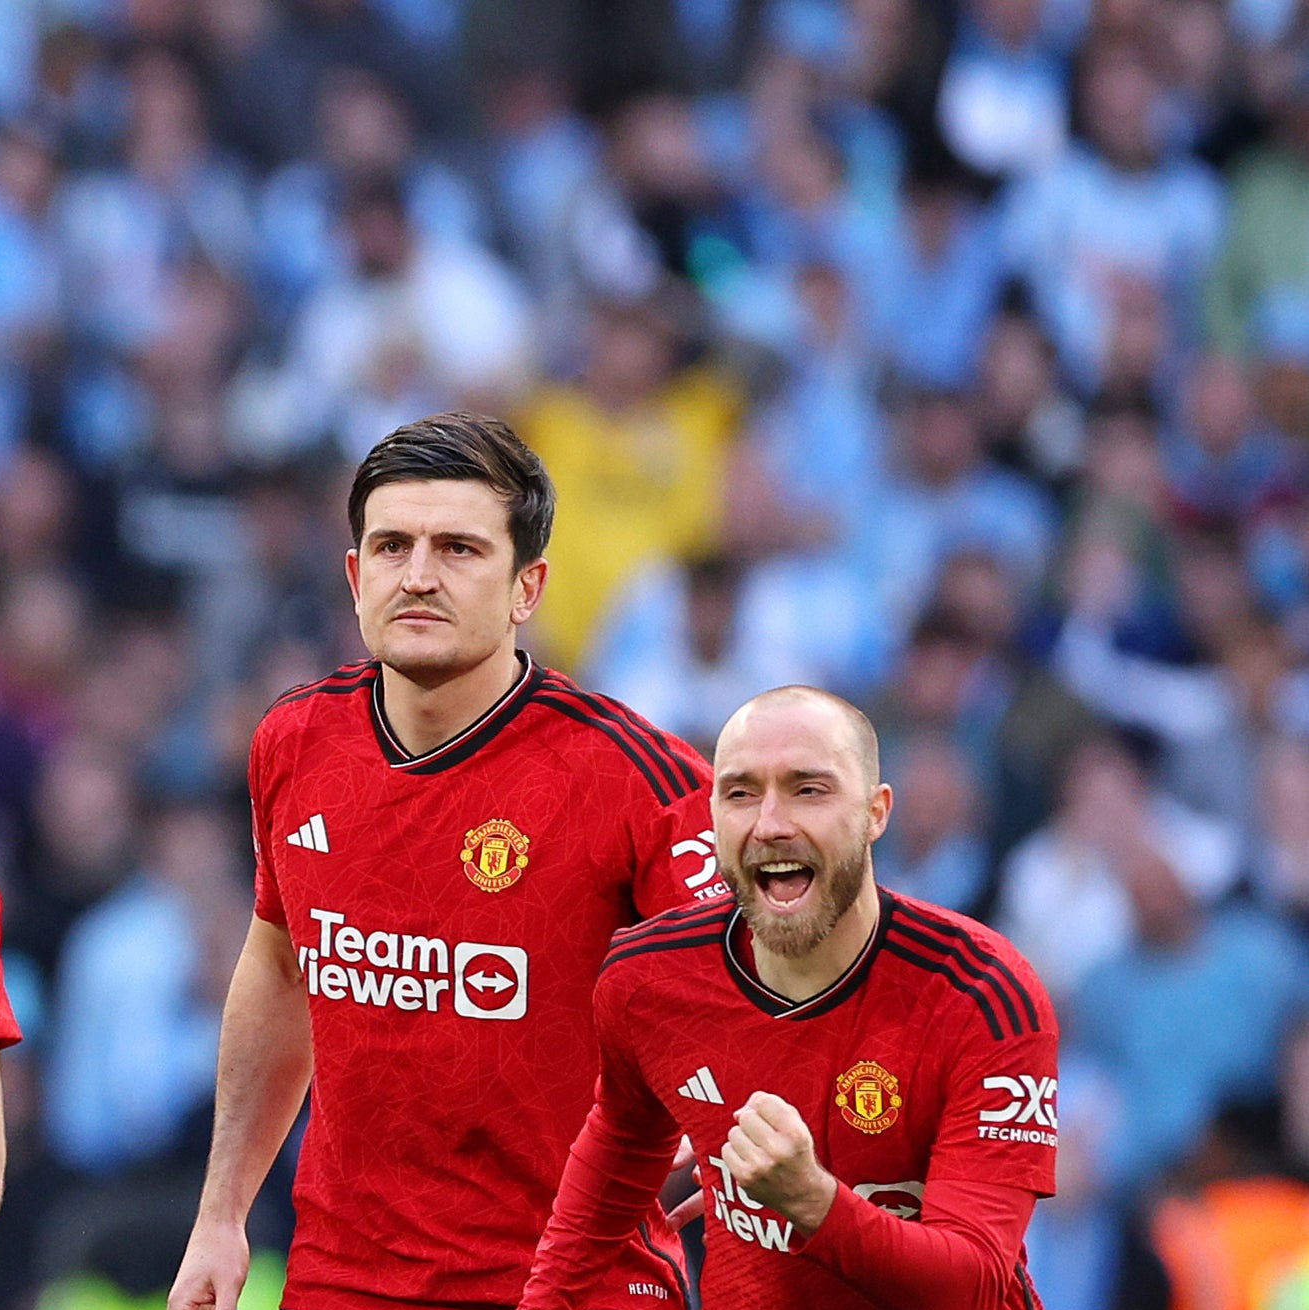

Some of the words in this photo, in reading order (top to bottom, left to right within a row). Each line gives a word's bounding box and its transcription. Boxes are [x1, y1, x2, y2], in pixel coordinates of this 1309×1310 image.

[470, 824, 525, 850] MANCHESTER
[473, 873, 511, 888] UNITED
[310, 908, 449, 974] Team
[842, 1066, 895, 1090] MANCHESTER
[853, 1117, 890, 1129] UNITED
[711, 1185, 794, 1252] View
